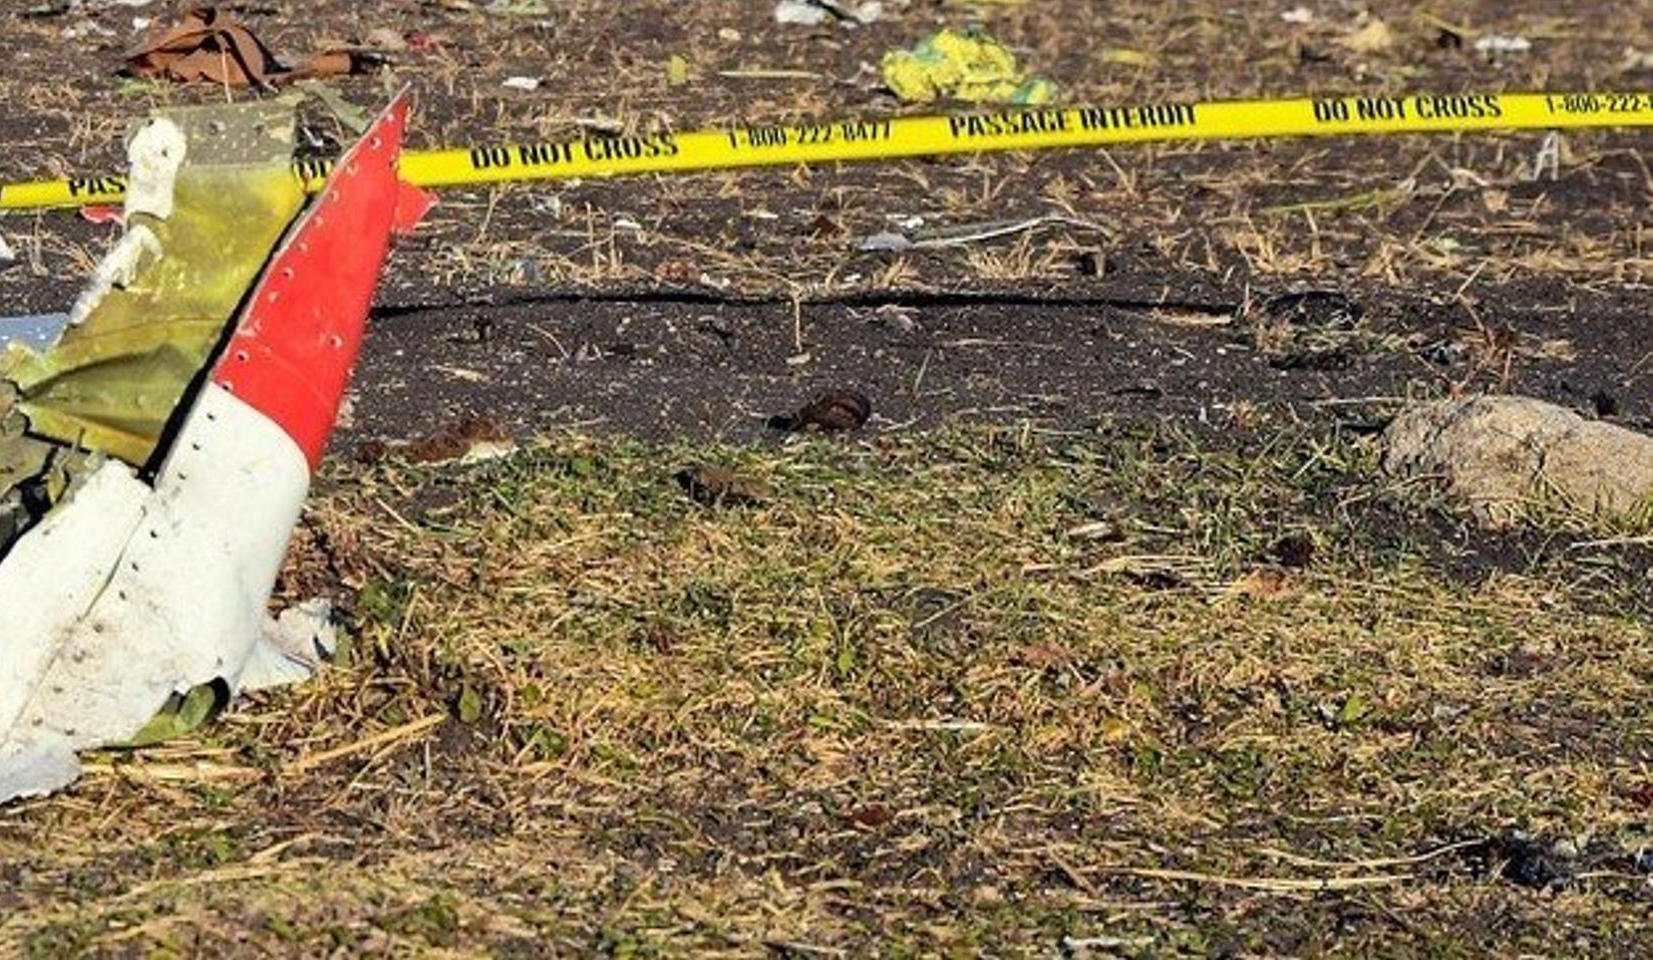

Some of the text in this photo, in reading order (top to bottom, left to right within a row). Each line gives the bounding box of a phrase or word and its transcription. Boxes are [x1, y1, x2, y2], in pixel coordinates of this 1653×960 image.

[1313, 94, 1502, 121] DO NOT CROSS
[1546, 95, 1653, 114] 1-800-222-
[949, 104, 1196, 137] PASSAGE INTERDIT
[470, 133, 679, 169] DO NOT CROSS
